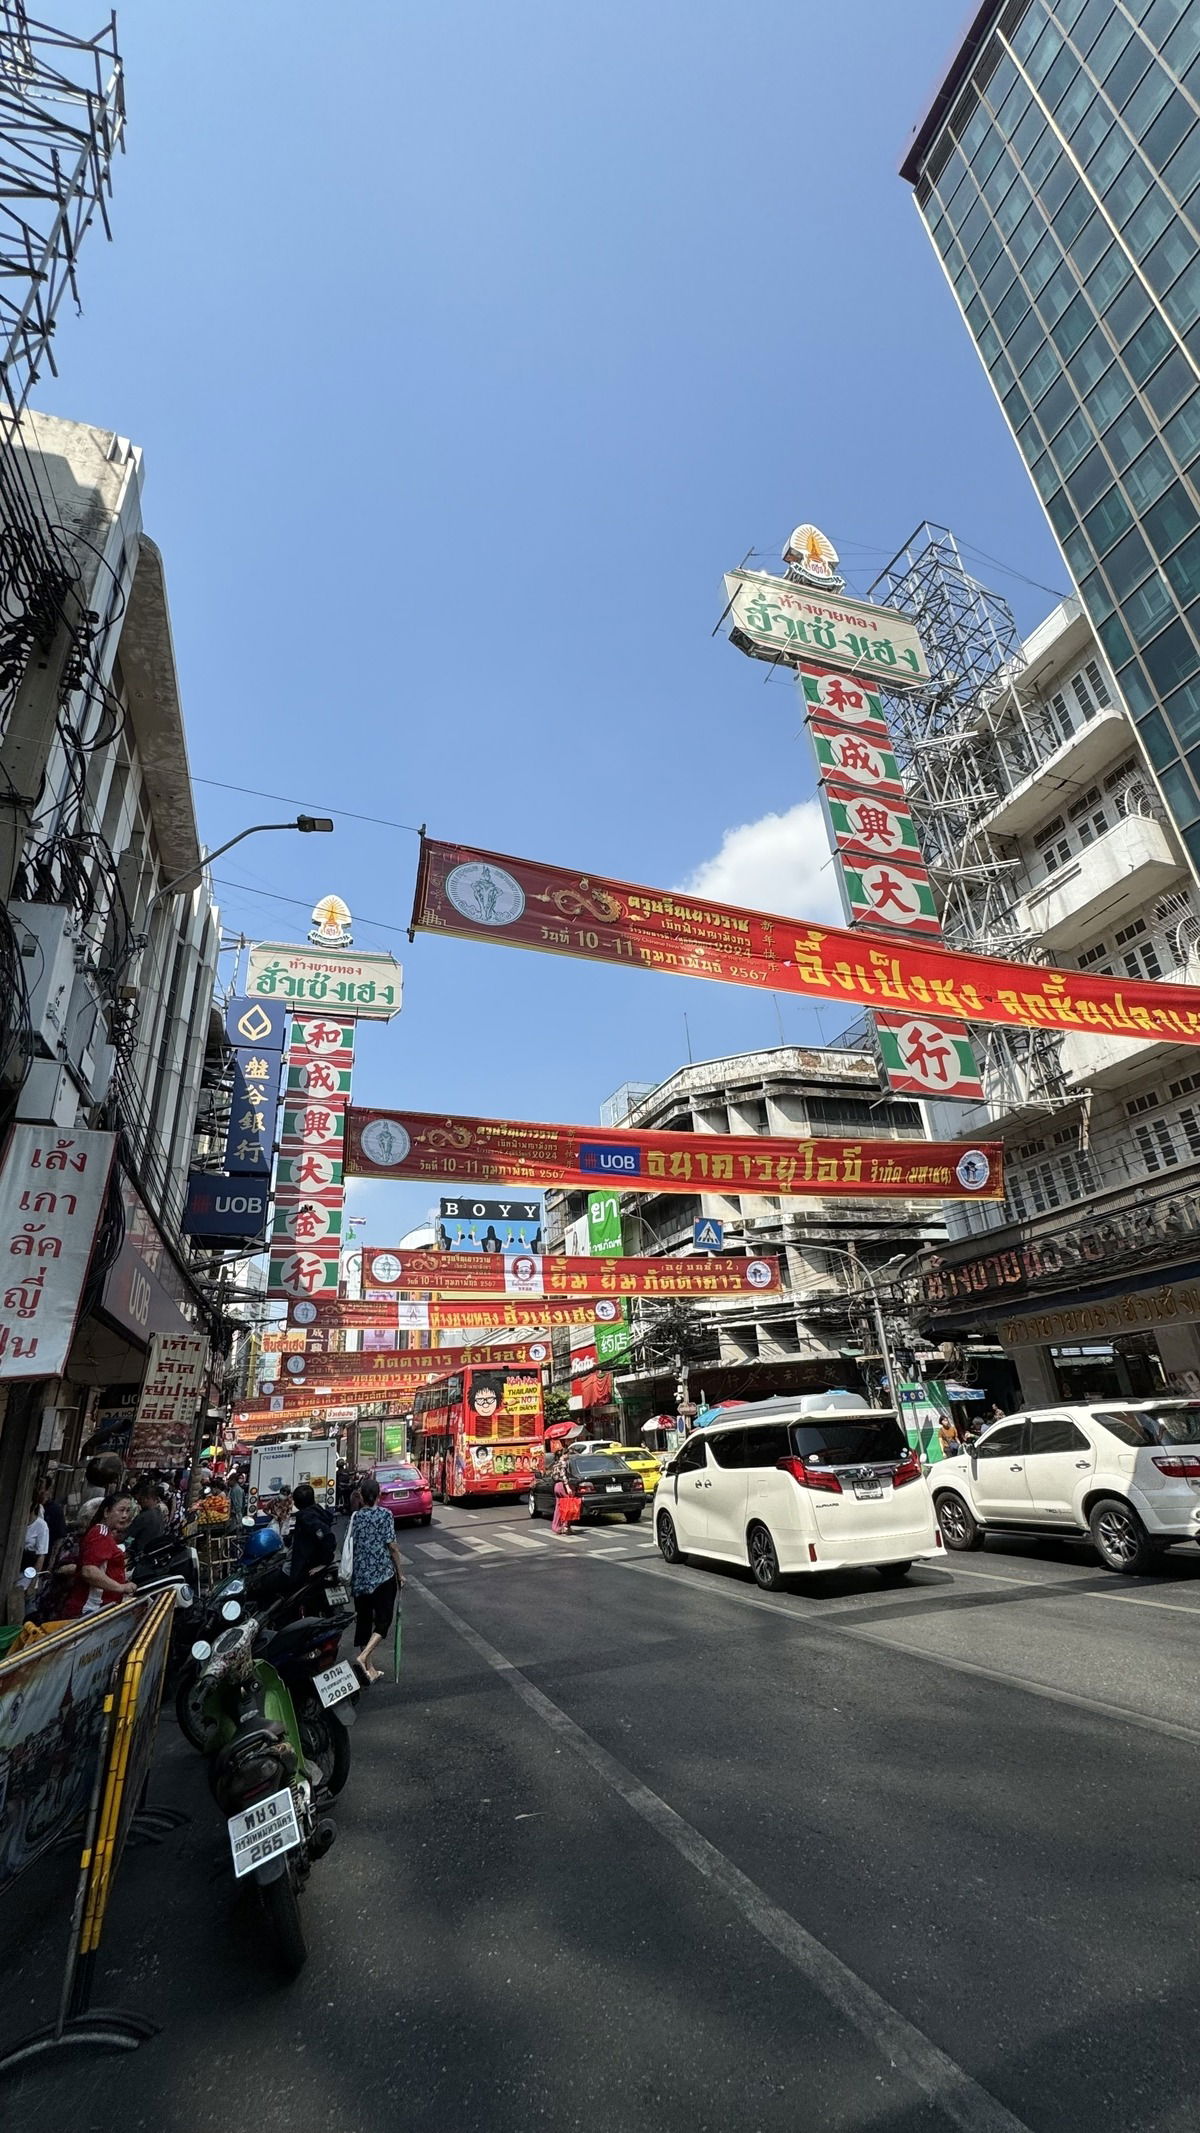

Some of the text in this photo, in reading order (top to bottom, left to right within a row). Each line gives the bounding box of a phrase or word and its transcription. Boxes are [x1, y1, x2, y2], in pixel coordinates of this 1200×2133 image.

[778, 594, 877, 631] ห้างขายทอง
[744, 592, 920, 673] ฮั่วเซ่งเฮง
[628, 895, 749, 932] ตรุษจีนเยาวราช
[289, 957, 361, 976] ห้างขายทอง
[540, 926, 570, 945] วันที่
[639, 946, 722, 974] กุมภาพันธ์
[729, 965, 768, 982] 2567
[256, 961, 395, 1005] ฮั่วเซ่งเฮง
[905, 1026, 951, 1083] 行
[31, 1139, 88, 1173] เล้ง
[420, 1158, 438, 1172] วันที่
[481, 1158, 536, 1179] กุมภาพันธ์
[539, 1169, 566, 1180] 2567
[532, 1151, 558, 1160] 2024
[600, 1154, 635, 1171] UOB
[647, 1141, 863, 1193] ธนาคารยูโอบี
[871, 1159, 903, 1183] จำกัด
[19, 1190, 77, 1215] เกา
[215, 1196, 263, 1214] UOB
[445, 1202, 537, 1218] BOYY
[591, 1197, 618, 1224] ยา
[551, 1258, 742, 1290] ยิ้ม ยิ้ม ภัตตาคาร
[4, 1266, 48, 1318] ญี่
[128, 1268, 151, 1326] UOB
[600, 1332, 627, 1353] 药店
[121, 1393, 138, 1405] UO
[507, 1387, 537, 1396] THAILAND
[328, 1682, 354, 1703] 2098
[250, 1832, 284, 1864] 265
